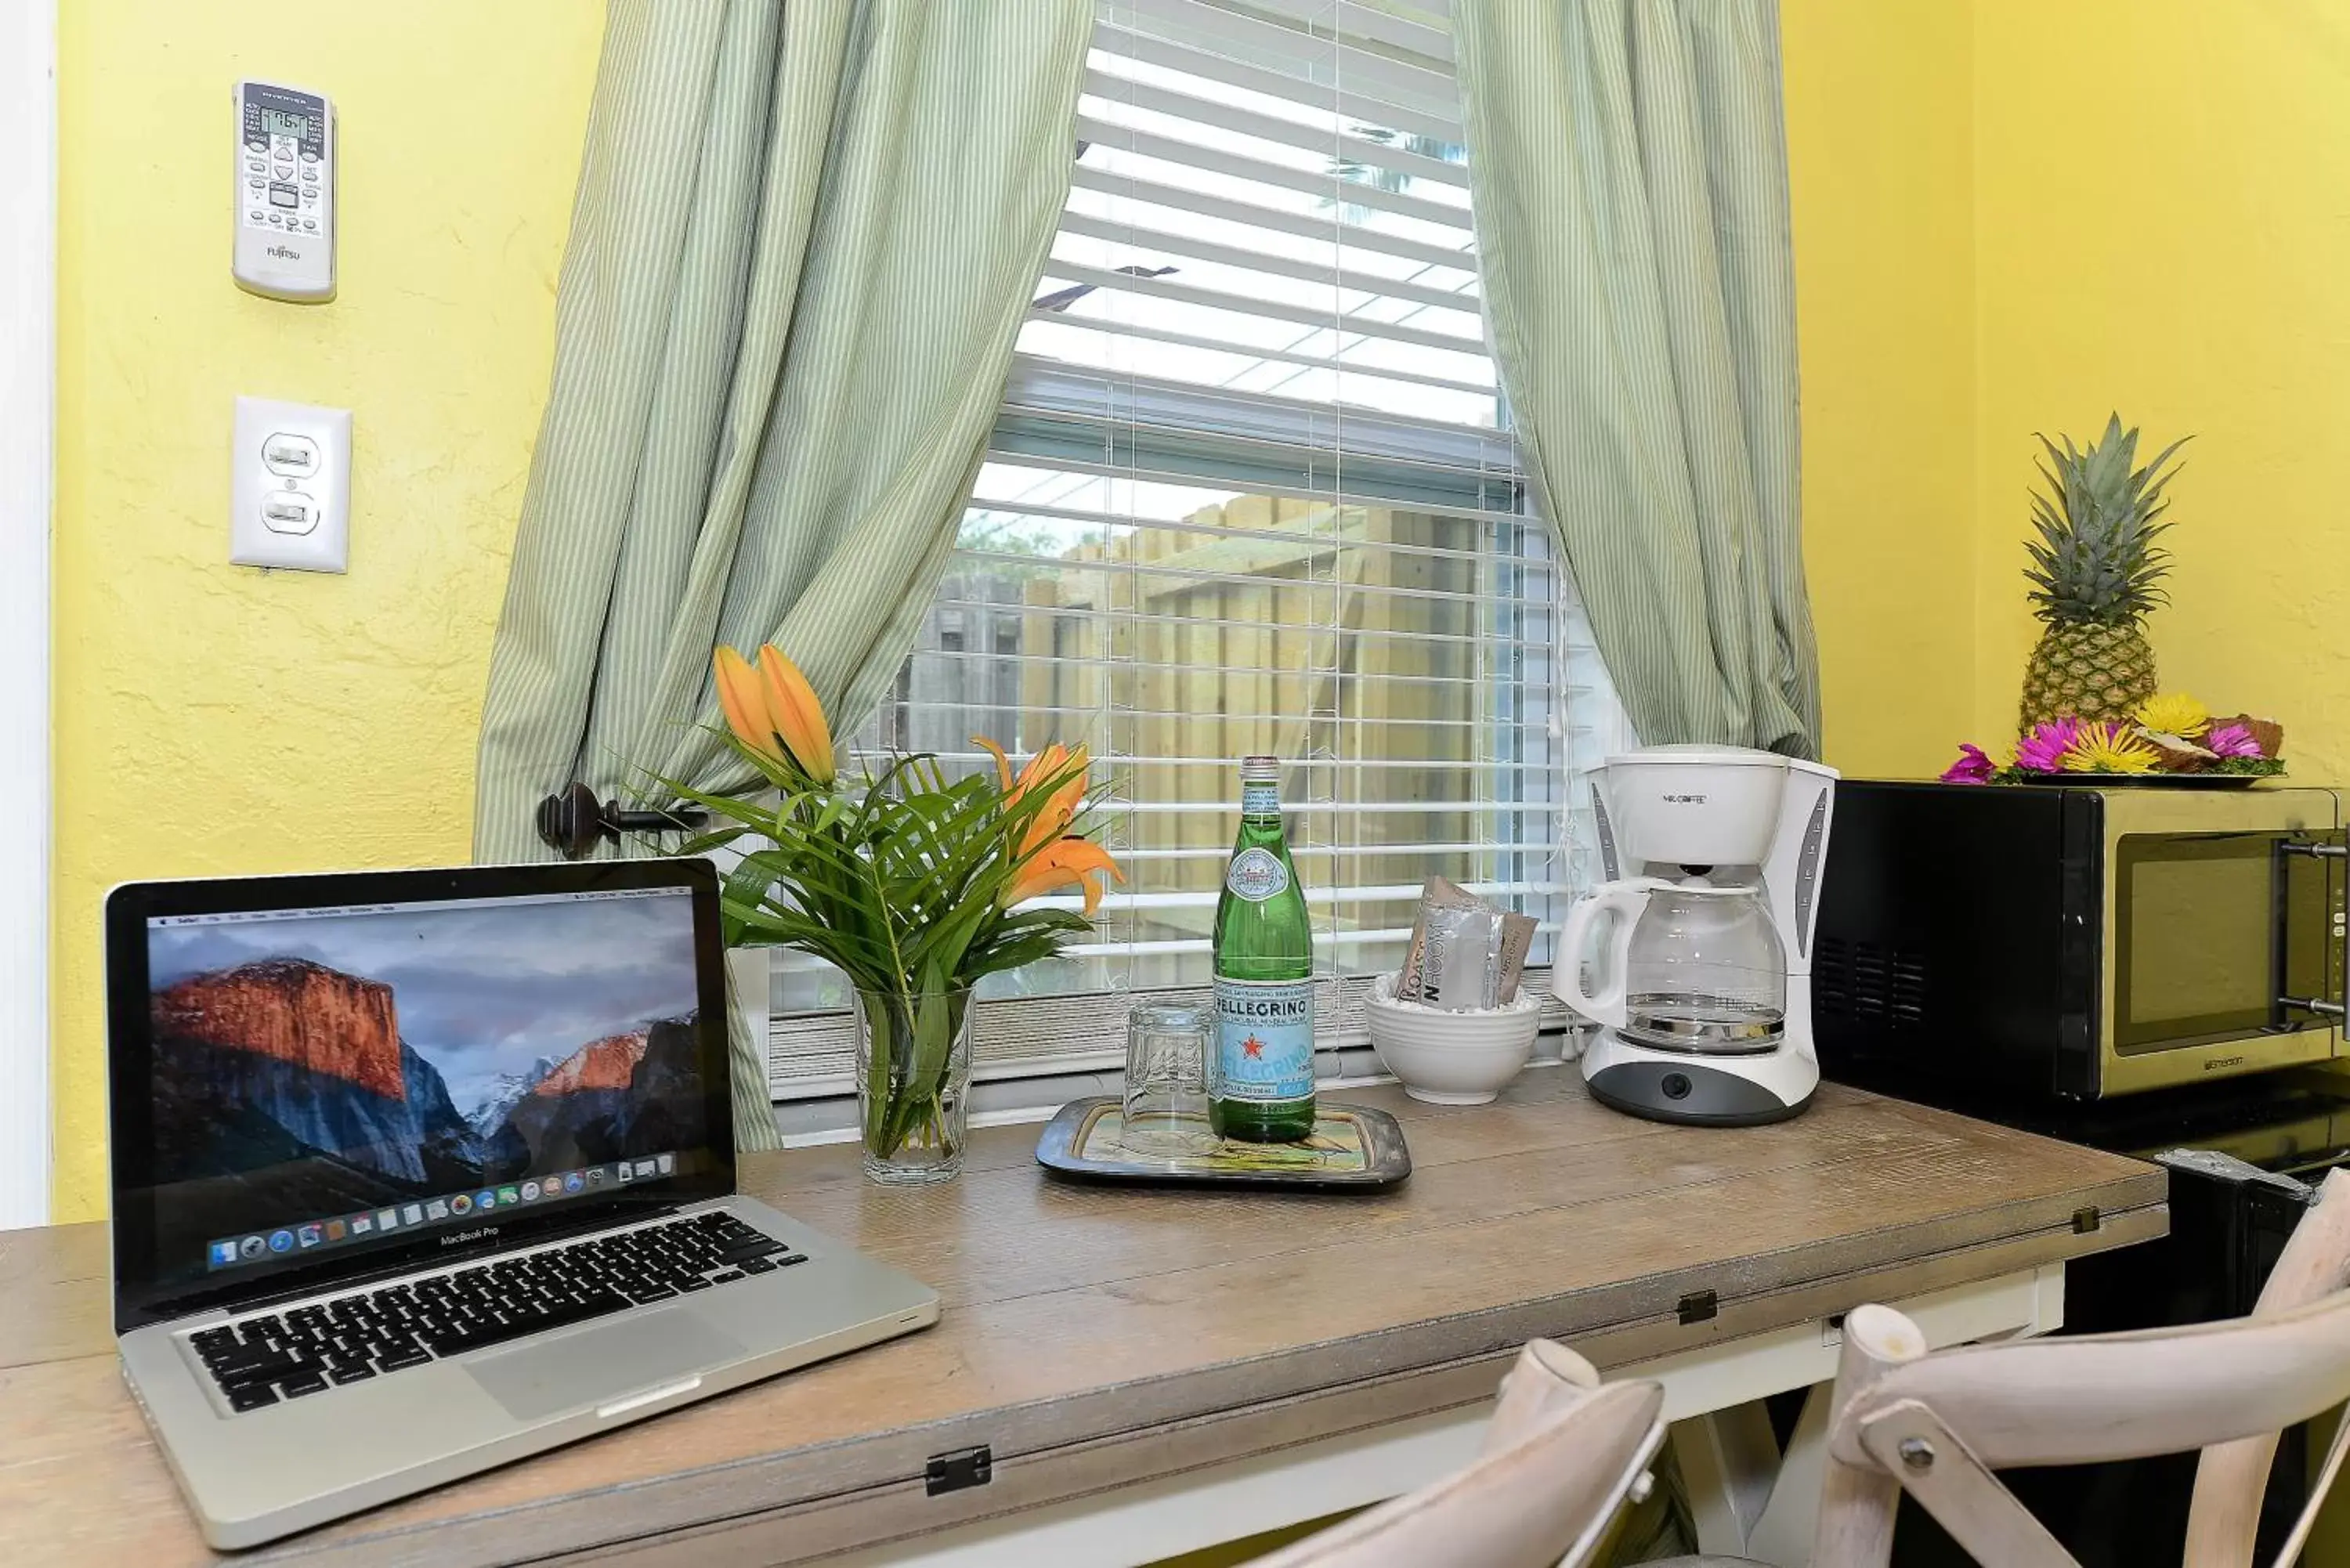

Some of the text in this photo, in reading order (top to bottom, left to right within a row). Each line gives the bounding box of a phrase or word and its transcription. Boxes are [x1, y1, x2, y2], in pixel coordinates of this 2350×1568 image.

[267, 244, 300, 261] FUJITSU
[441, 1227, 499, 1246] MacBook Pro
